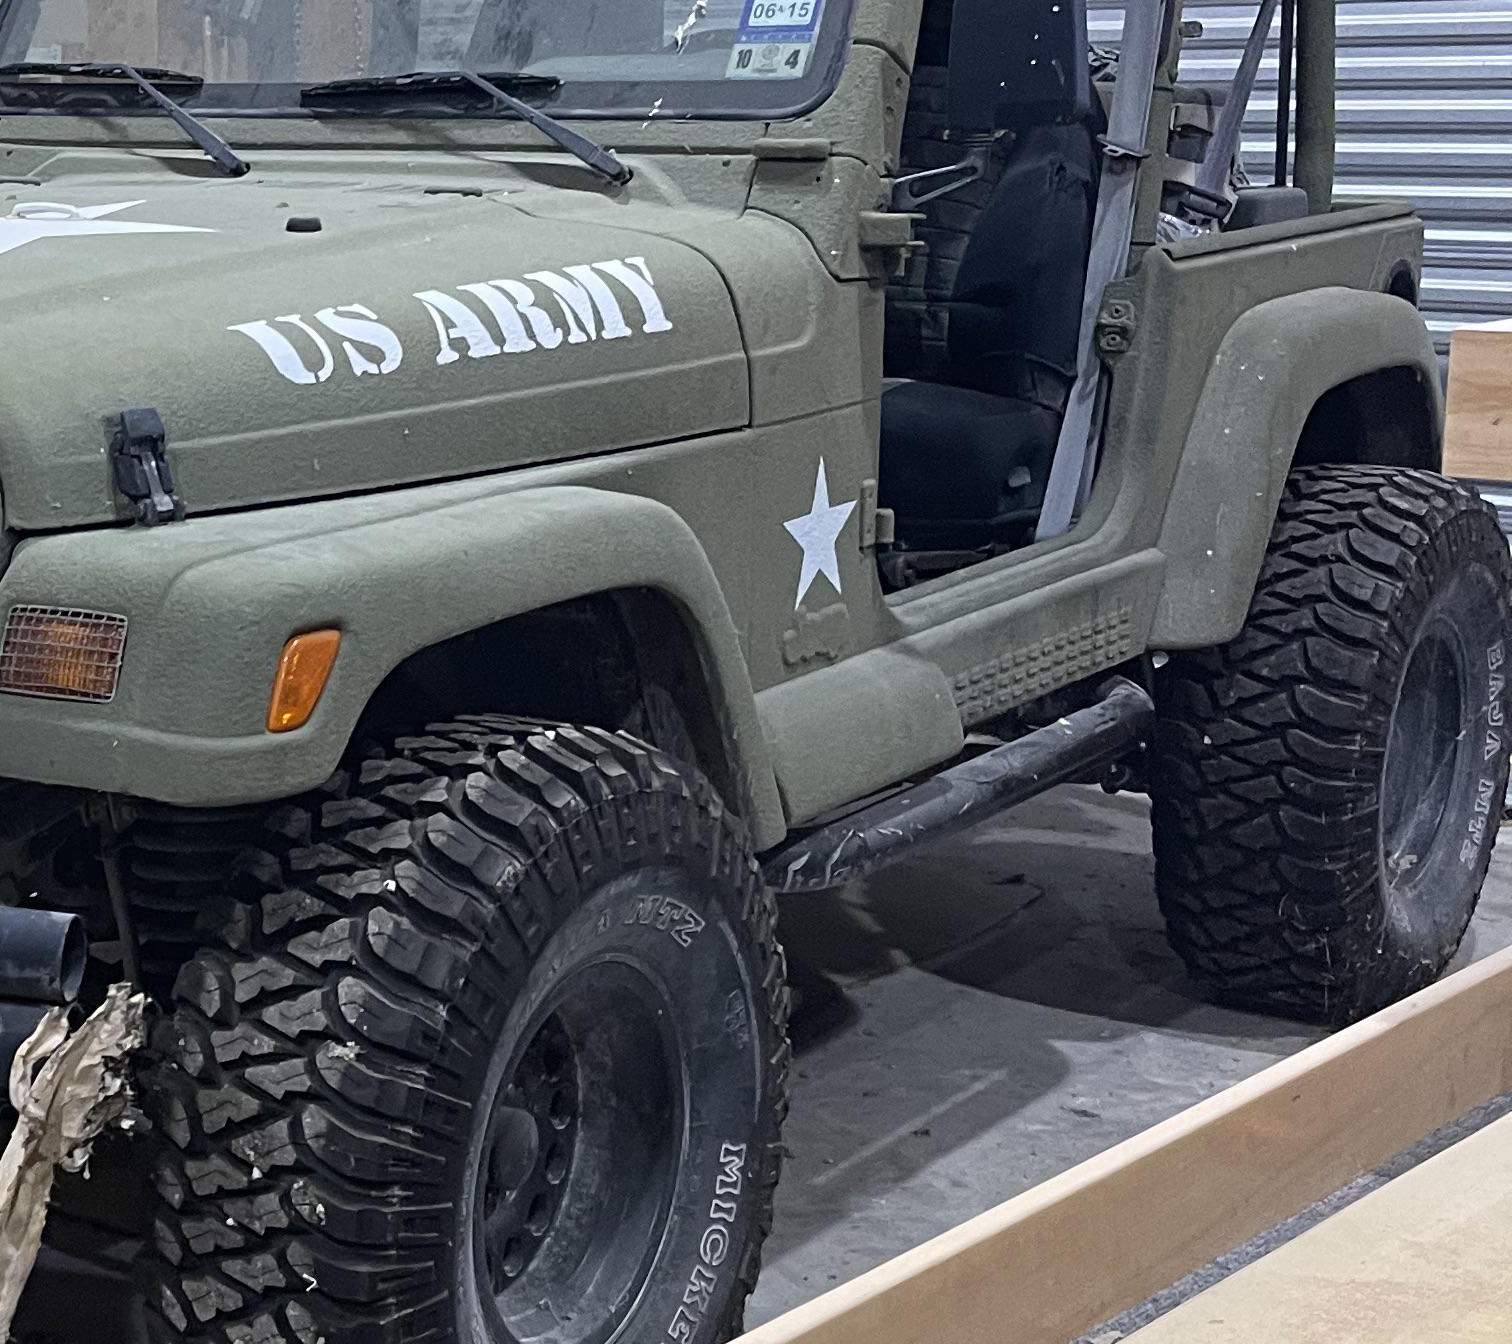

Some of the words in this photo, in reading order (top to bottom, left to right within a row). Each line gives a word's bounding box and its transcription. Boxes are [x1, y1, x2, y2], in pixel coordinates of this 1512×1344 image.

[736, 48, 753, 70] 10
[227, 303, 404, 385] US
[412, 256, 674, 366] ARMY
[1483, 640, 1505, 761] BAJA
